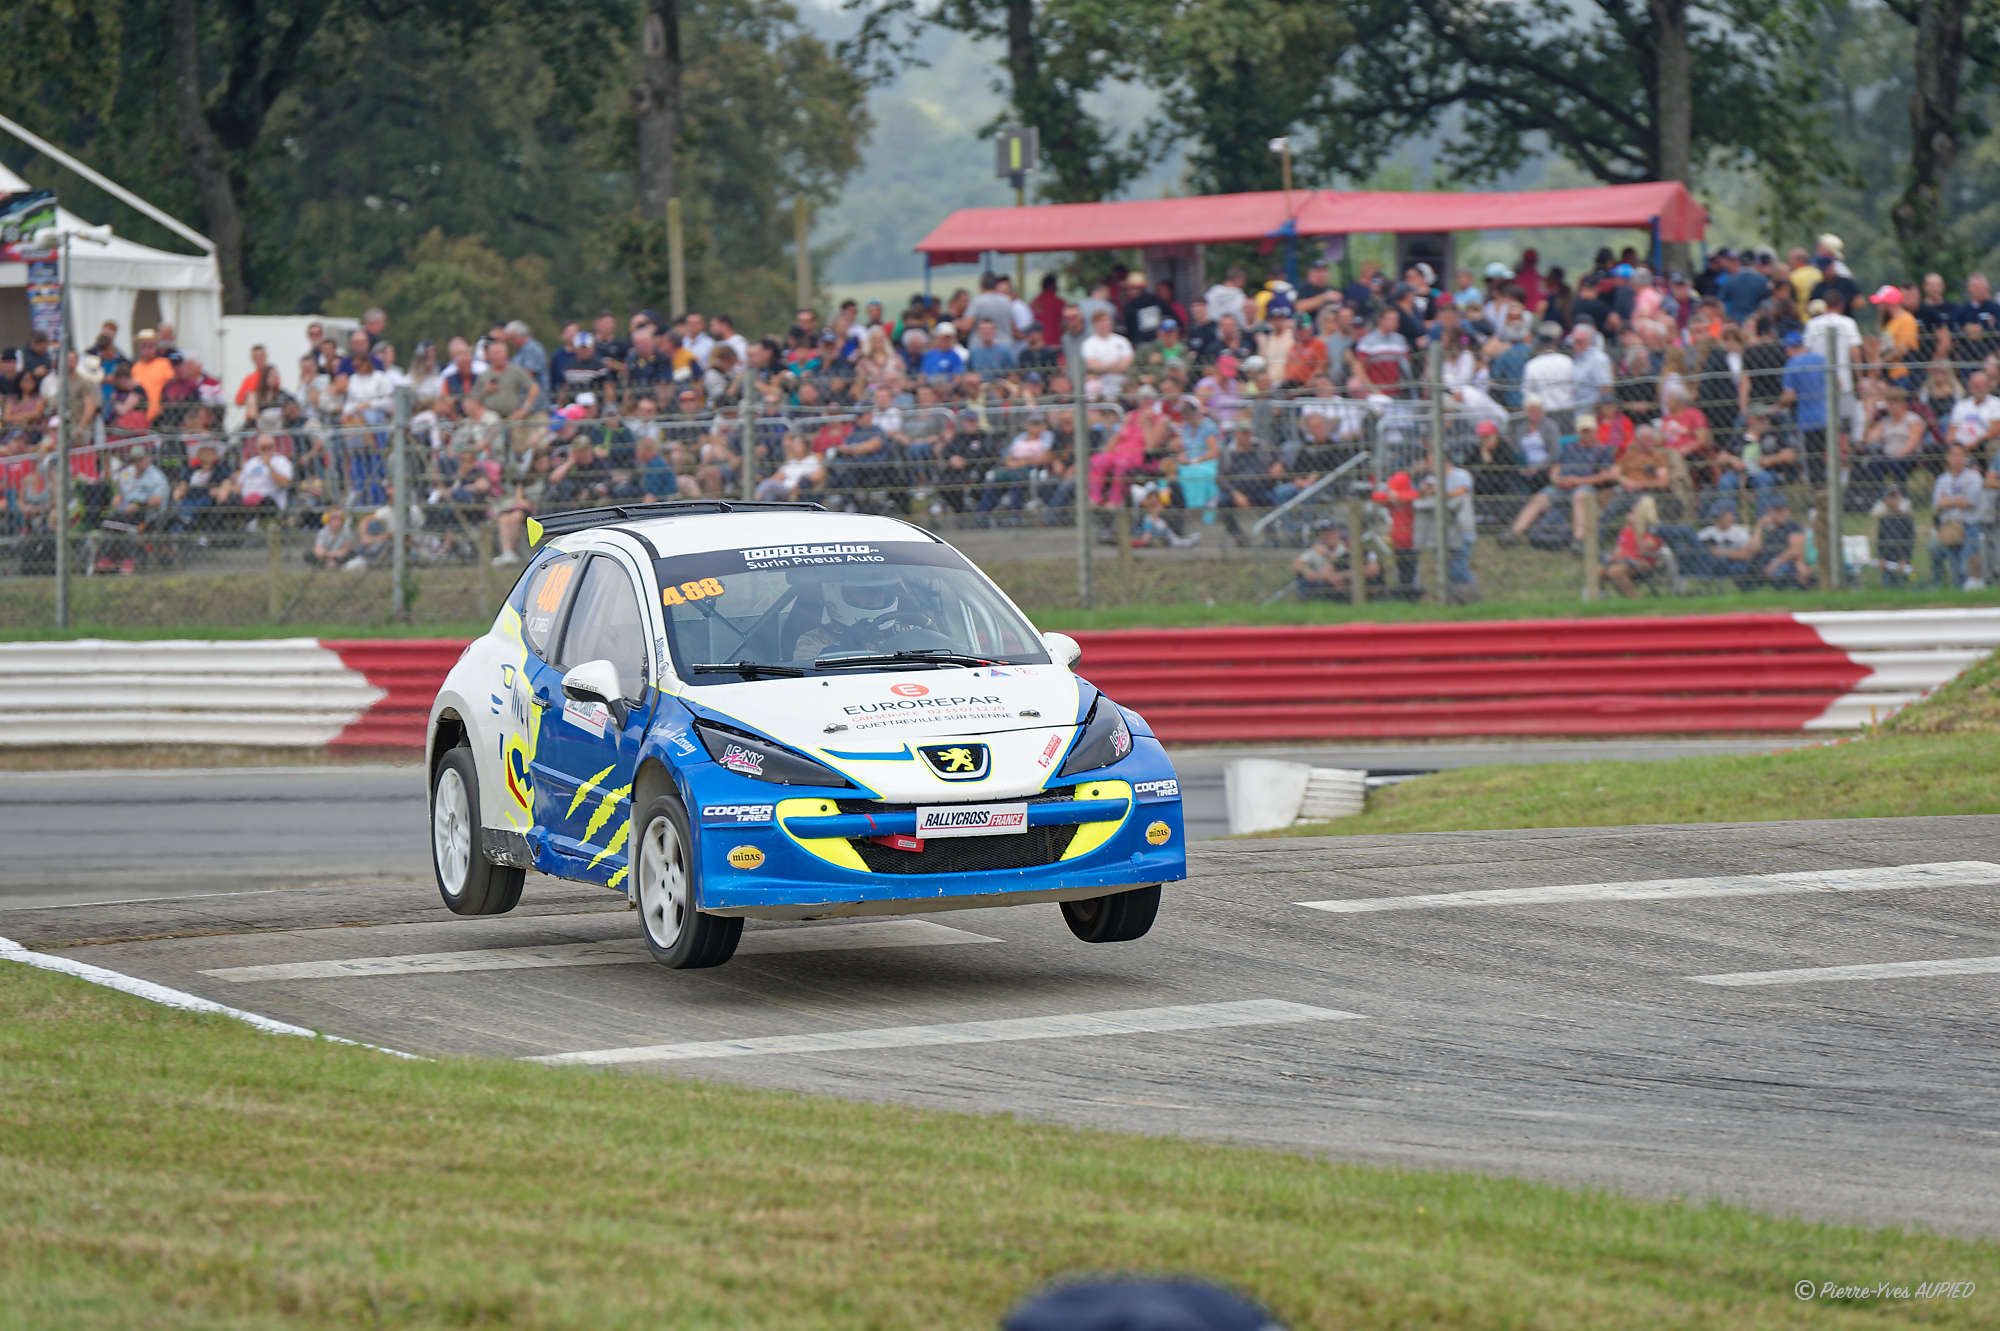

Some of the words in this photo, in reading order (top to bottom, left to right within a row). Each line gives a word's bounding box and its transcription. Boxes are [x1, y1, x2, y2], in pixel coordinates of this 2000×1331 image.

[746, 558, 790, 570] Surin
[792, 555, 843, 565] Pneus
[846, 554, 885, 562] Auto
[662, 577, 725, 607] 488
[842, 695, 1002, 715] EUROREPAR
[856, 715, 942, 729] QUETTREVILLE
[968, 711, 1012, 720] SIENNE
[1134, 779, 1177, 793] COOPER
[1156, 788, 1179, 797] TIRES
[702, 805, 774, 816] COOPER
[735, 814, 771, 822] TIRES
[924, 811, 991, 827] RALLYCROSS
[991, 814, 1024, 826] FRANCE
